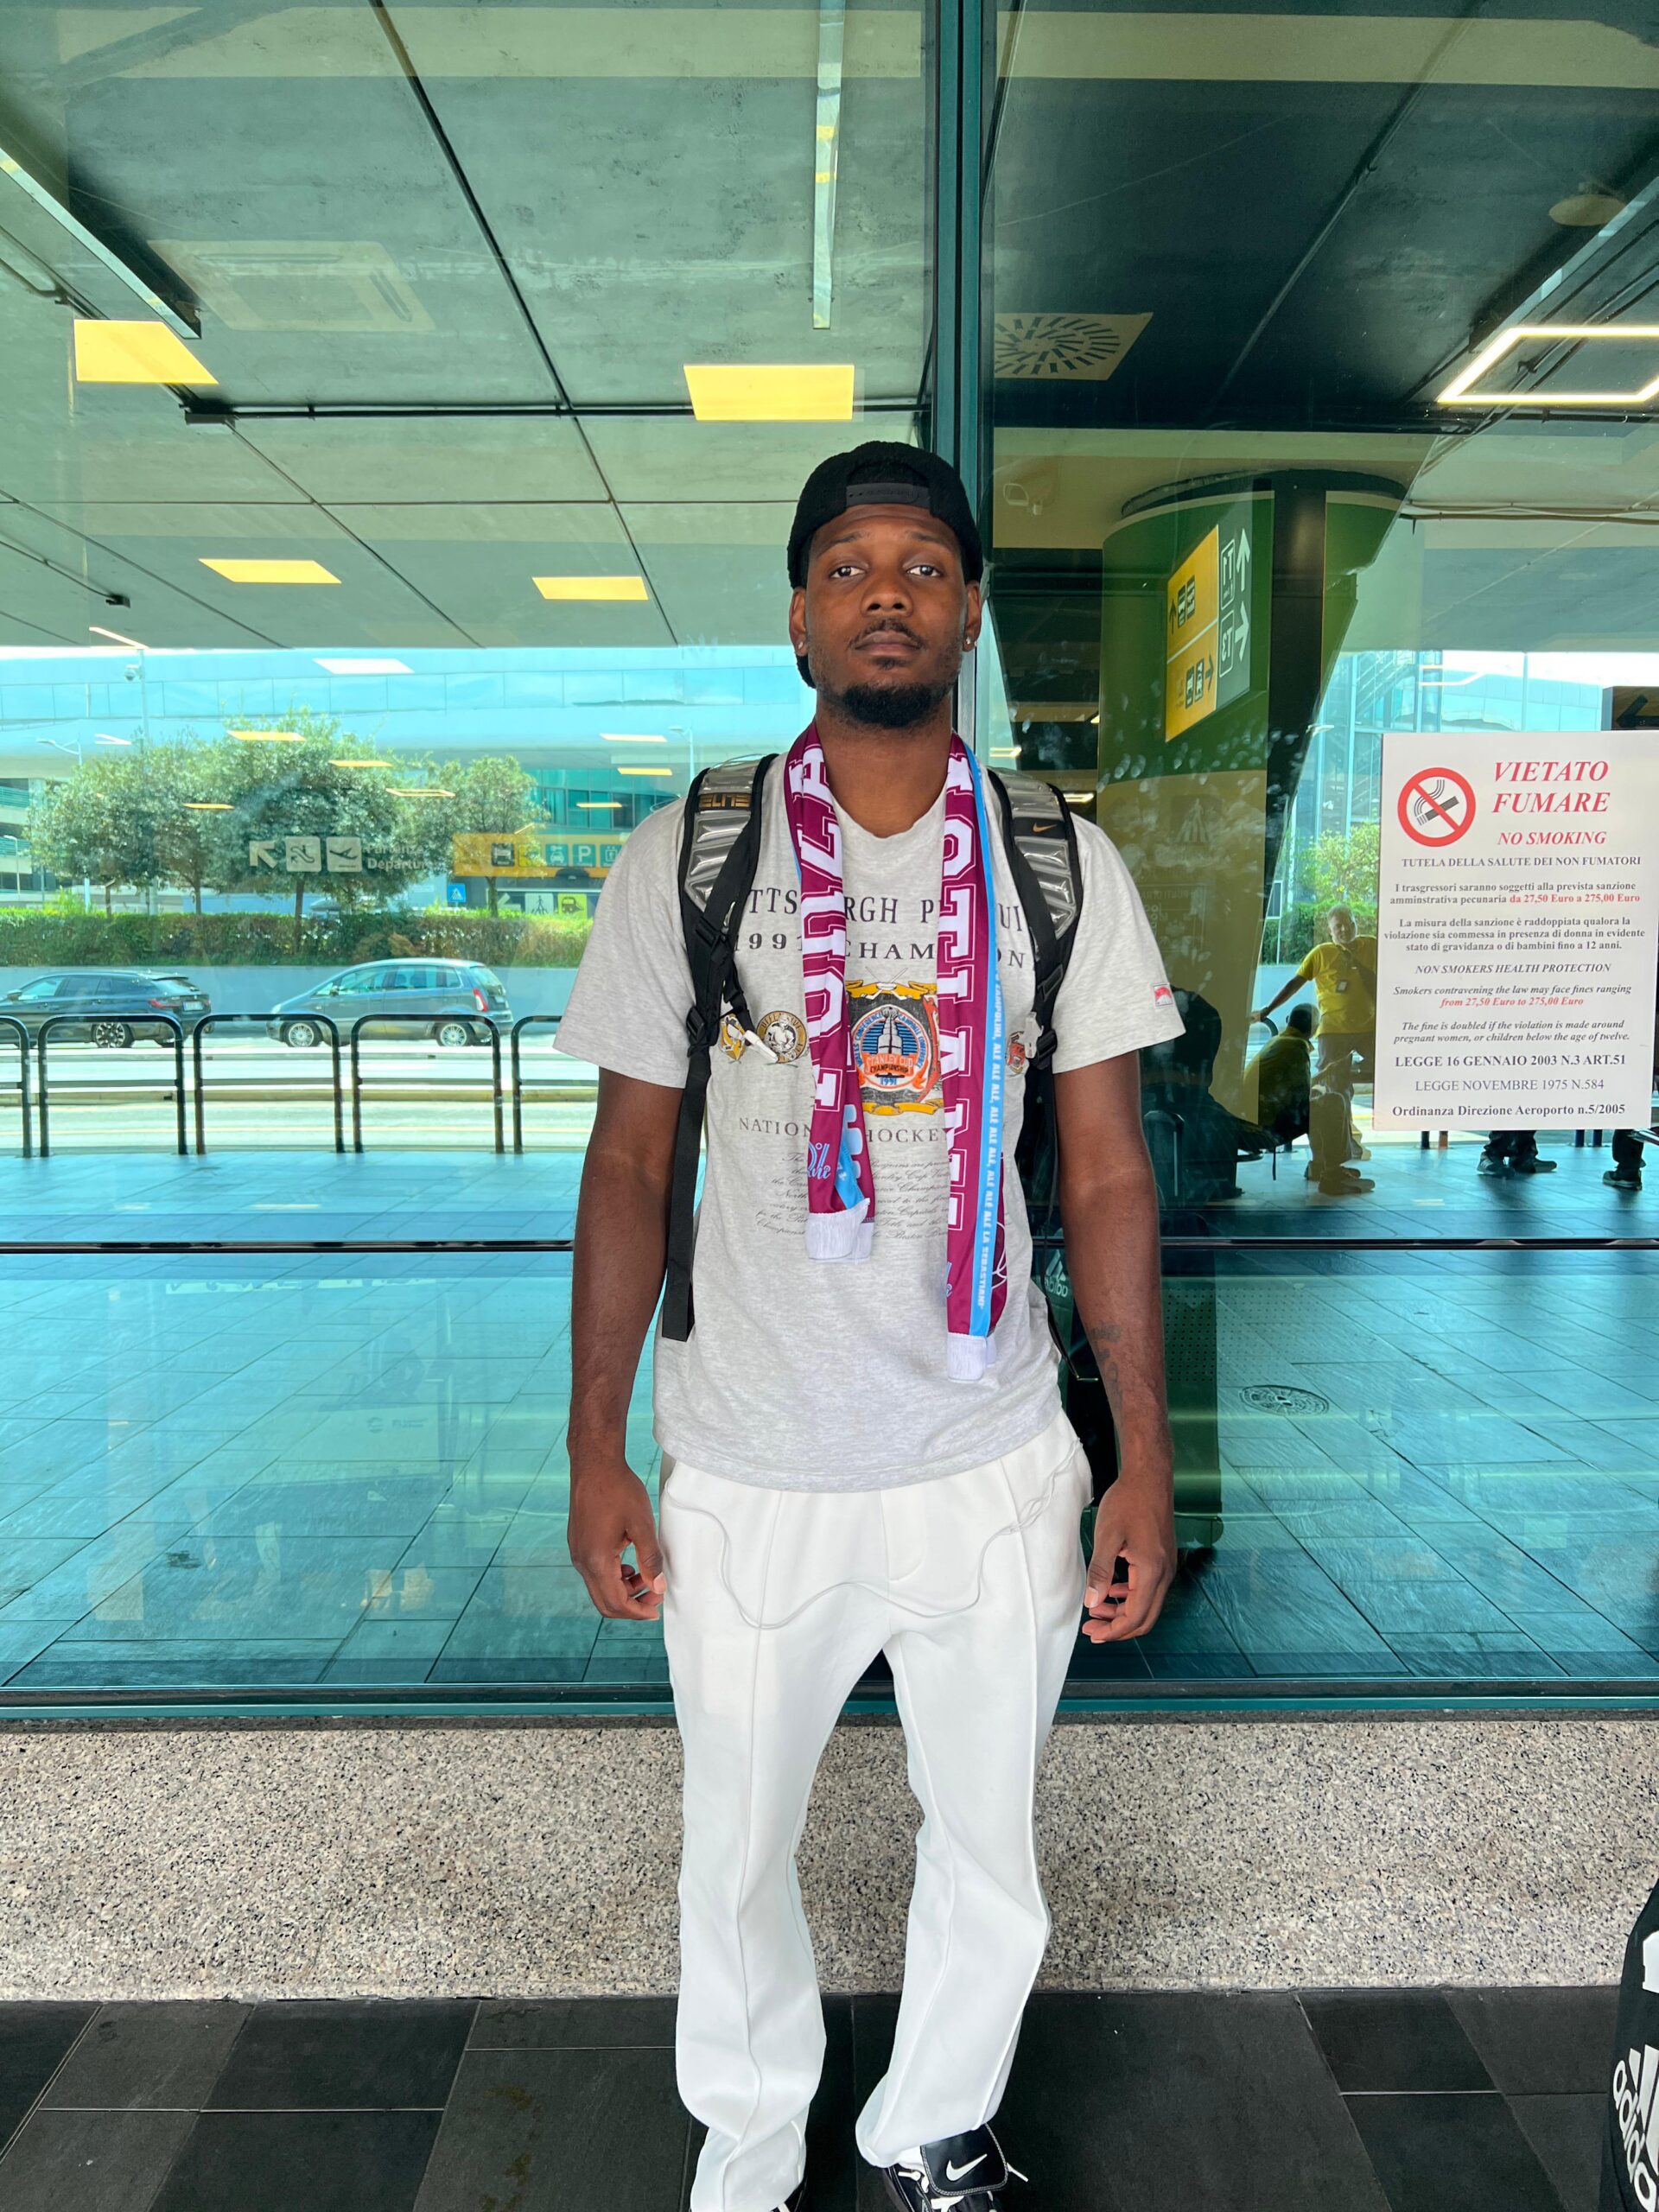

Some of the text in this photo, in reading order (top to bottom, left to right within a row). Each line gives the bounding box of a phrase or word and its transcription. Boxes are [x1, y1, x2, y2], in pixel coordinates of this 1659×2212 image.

[1494, 760, 1609, 782] VIETATO
[700, 794, 750, 807] ELITE
[1492, 791, 1611, 813] FUMARE
[1497, 831, 1607, 845] NO SMOKING
[578, 846, 591, 862] P
[1402, 856, 1641, 867] TUTELA DELLA SALUTE DEI NON FUMATORI
[1402, 883, 1457, 893] trasgressori
[1499, 883, 1535, 893] soggetti
[1537, 882, 1554, 891] alla
[1556, 882, 1593, 892] prevista
[1389, 895, 1458, 905] amminstrativa
[1460, 895, 1507, 906] pecunaria
[1510, 894, 1521, 903] da
[1524, 894, 1548, 904] 27,50
[1551, 894, 1574, 903] Euro
[1585, 893, 1614, 904] 275,00
[1618, 893, 1640, 902] Euro
[1400, 918, 1412, 927] La
[1414, 918, 1446, 927] misura
[1474, 918, 1515, 926] sanzione
[1524, 918, 1581, 927] raddoppiata
[1583, 917, 1619, 927] qualora
[1622, 917, 1630, 925] la
[1383, 931, 1430, 939] violazione
[1432, 931, 1445, 939] sia
[1497, 930, 1506, 938] in
[1509, 931, 1549, 940] presenza
[1552, 930, 1561, 938] di
[1564, 929, 1592, 938] donna
[1595, 929, 1604, 938] in
[1606, 929, 1645, 938] evidente
[1431, 943, 1440, 951] di
[1442, 943, 1494, 953] gravidanza
[1504, 942, 1514, 950] di
[1516, 942, 1554, 950] bambini
[1586, 941, 1596, 950] 12
[1599, 941, 1622, 950] anni.
[1415, 963, 1611, 974] NON SMOKERS HEALTH PROTECTION
[1393, 984, 1631, 996] Smokers contravening the law may face fines ranging
[1440, 998, 1463, 1008] from
[1465, 997, 1491, 1007] 27,50
[1492, 997, 1515, 1006] Euro
[1529, 997, 1559, 1007] 275,00
[1561, 996, 1584, 1006] Euro
[1419, 1022, 1439, 1033] fine
[1440, 1021, 1449, 1030] is
[1450, 1021, 1487, 1030] doubled
[1488, 1021, 1498, 1032] if
[1514, 1020, 1553, 1029] violation
[1555, 1020, 1563, 1029] is
[1565, 1020, 1589, 1029] made
[1592, 1020, 1625, 1028] around
[1393, 1034, 1435, 1045] pregnant
[1486, 1033, 1523, 1042] children
[1526, 1033, 1552, 1041] below
[1554, 1033, 1568, 1041] the
[1570, 1033, 1586, 1042] age
[1588, 1032, 1599, 1043] of
[1599, 1032, 1630, 1041] twelve.
[865, 1053, 898, 1068] STANLEY
[1395, 1054, 1625, 1067] LEGGE 16 GENNAIO 2003 N.3 ART.51
[1415, 1079, 1605, 1091] LEGGE NOVEMBRE 1975 N.584
[1392, 1103, 1625, 1117] Ordinanza Direzione Aeroporto n.5/2005
[1613, 2060, 1656, 2212] adida
